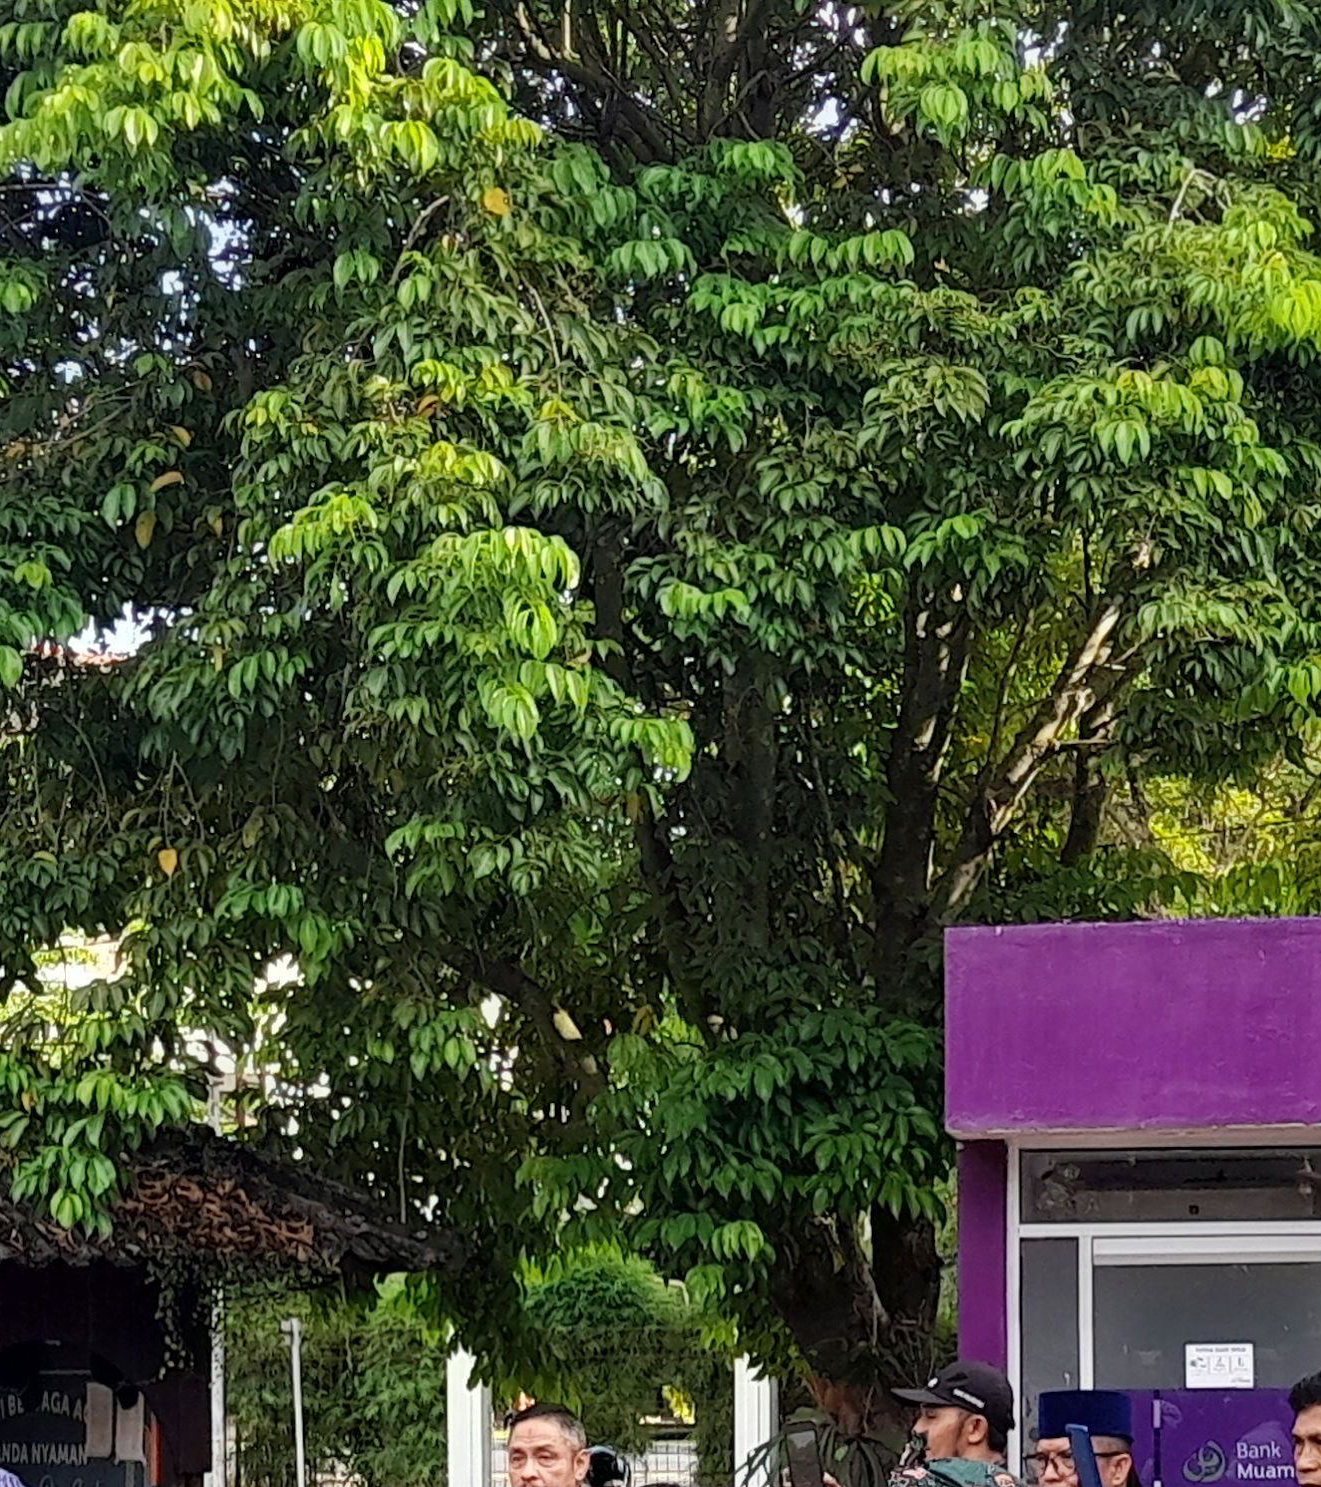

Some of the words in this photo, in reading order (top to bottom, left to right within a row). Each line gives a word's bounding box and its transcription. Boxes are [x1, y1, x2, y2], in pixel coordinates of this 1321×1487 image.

[31, 1442, 89, 1465] NYAMAN
[1236, 1440, 1282, 1459] Bank
[1236, 1463, 1295, 1480] Muam
